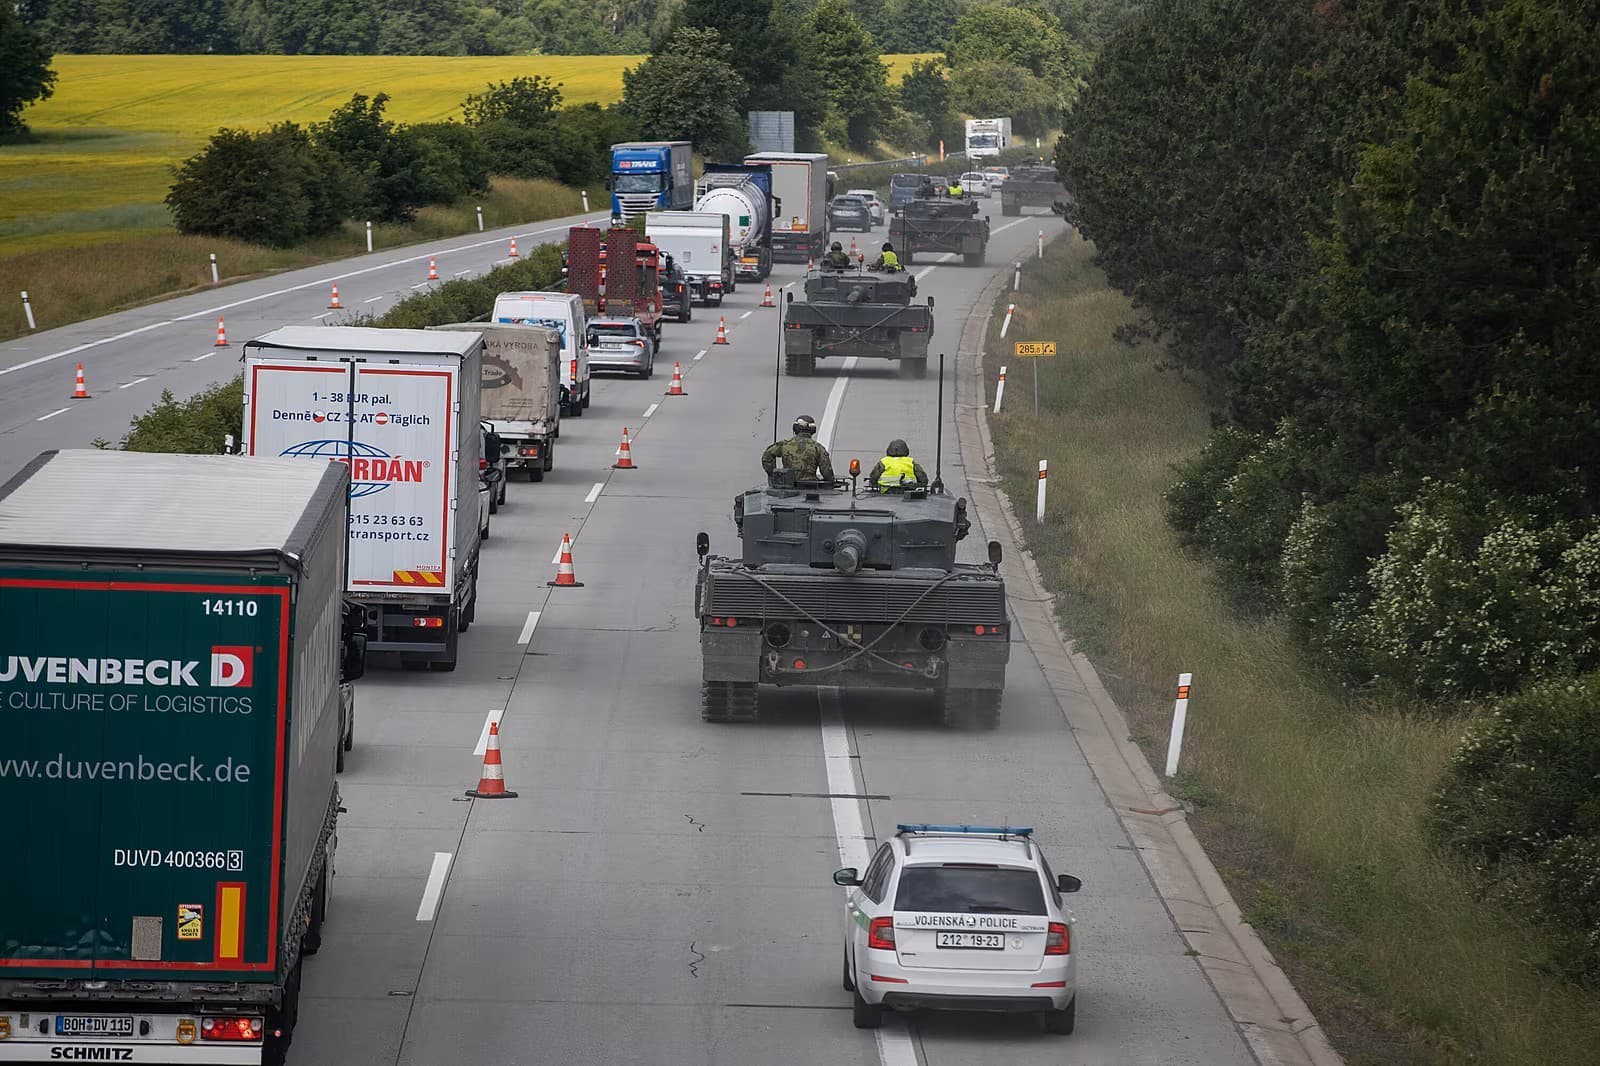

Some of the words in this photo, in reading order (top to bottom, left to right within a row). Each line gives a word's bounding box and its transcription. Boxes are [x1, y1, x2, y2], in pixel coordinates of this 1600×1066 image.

[312, 392, 318, 401] 1
[330, 392, 344, 403] 38
[371, 394, 392, 406] pal.
[272, 409, 311, 421] Denně
[326, 412, 341, 422] CZ
[360, 413, 375, 423] AT
[390, 414, 430, 427] Täglich
[373, 515, 388, 525] 23
[391, 516, 406, 526] 63
[409, 516, 424, 527] 63
[350, 530, 430, 542] transport.cz
[202, 600, 258, 616] 14110
[9, 691, 105, 711] CULTURE
[109, 694, 137, 711] OF
[144, 695, 252, 714] LOGISTICS
[114, 849, 162, 867] DUVD
[164, 850, 225, 869] 400366
[914, 915, 965, 927] VOJENSKÁ
[979, 918, 1018, 929] POLICIE
[942, 934, 962, 945] 212
[970, 936, 999, 946] 19-23
[64, 1018, 85, 1031] BOH
[93, 1019, 108, 1032] DV
[110, 1019, 131, 1032] 115
[50, 1047, 134, 1061] SCHMITZ
